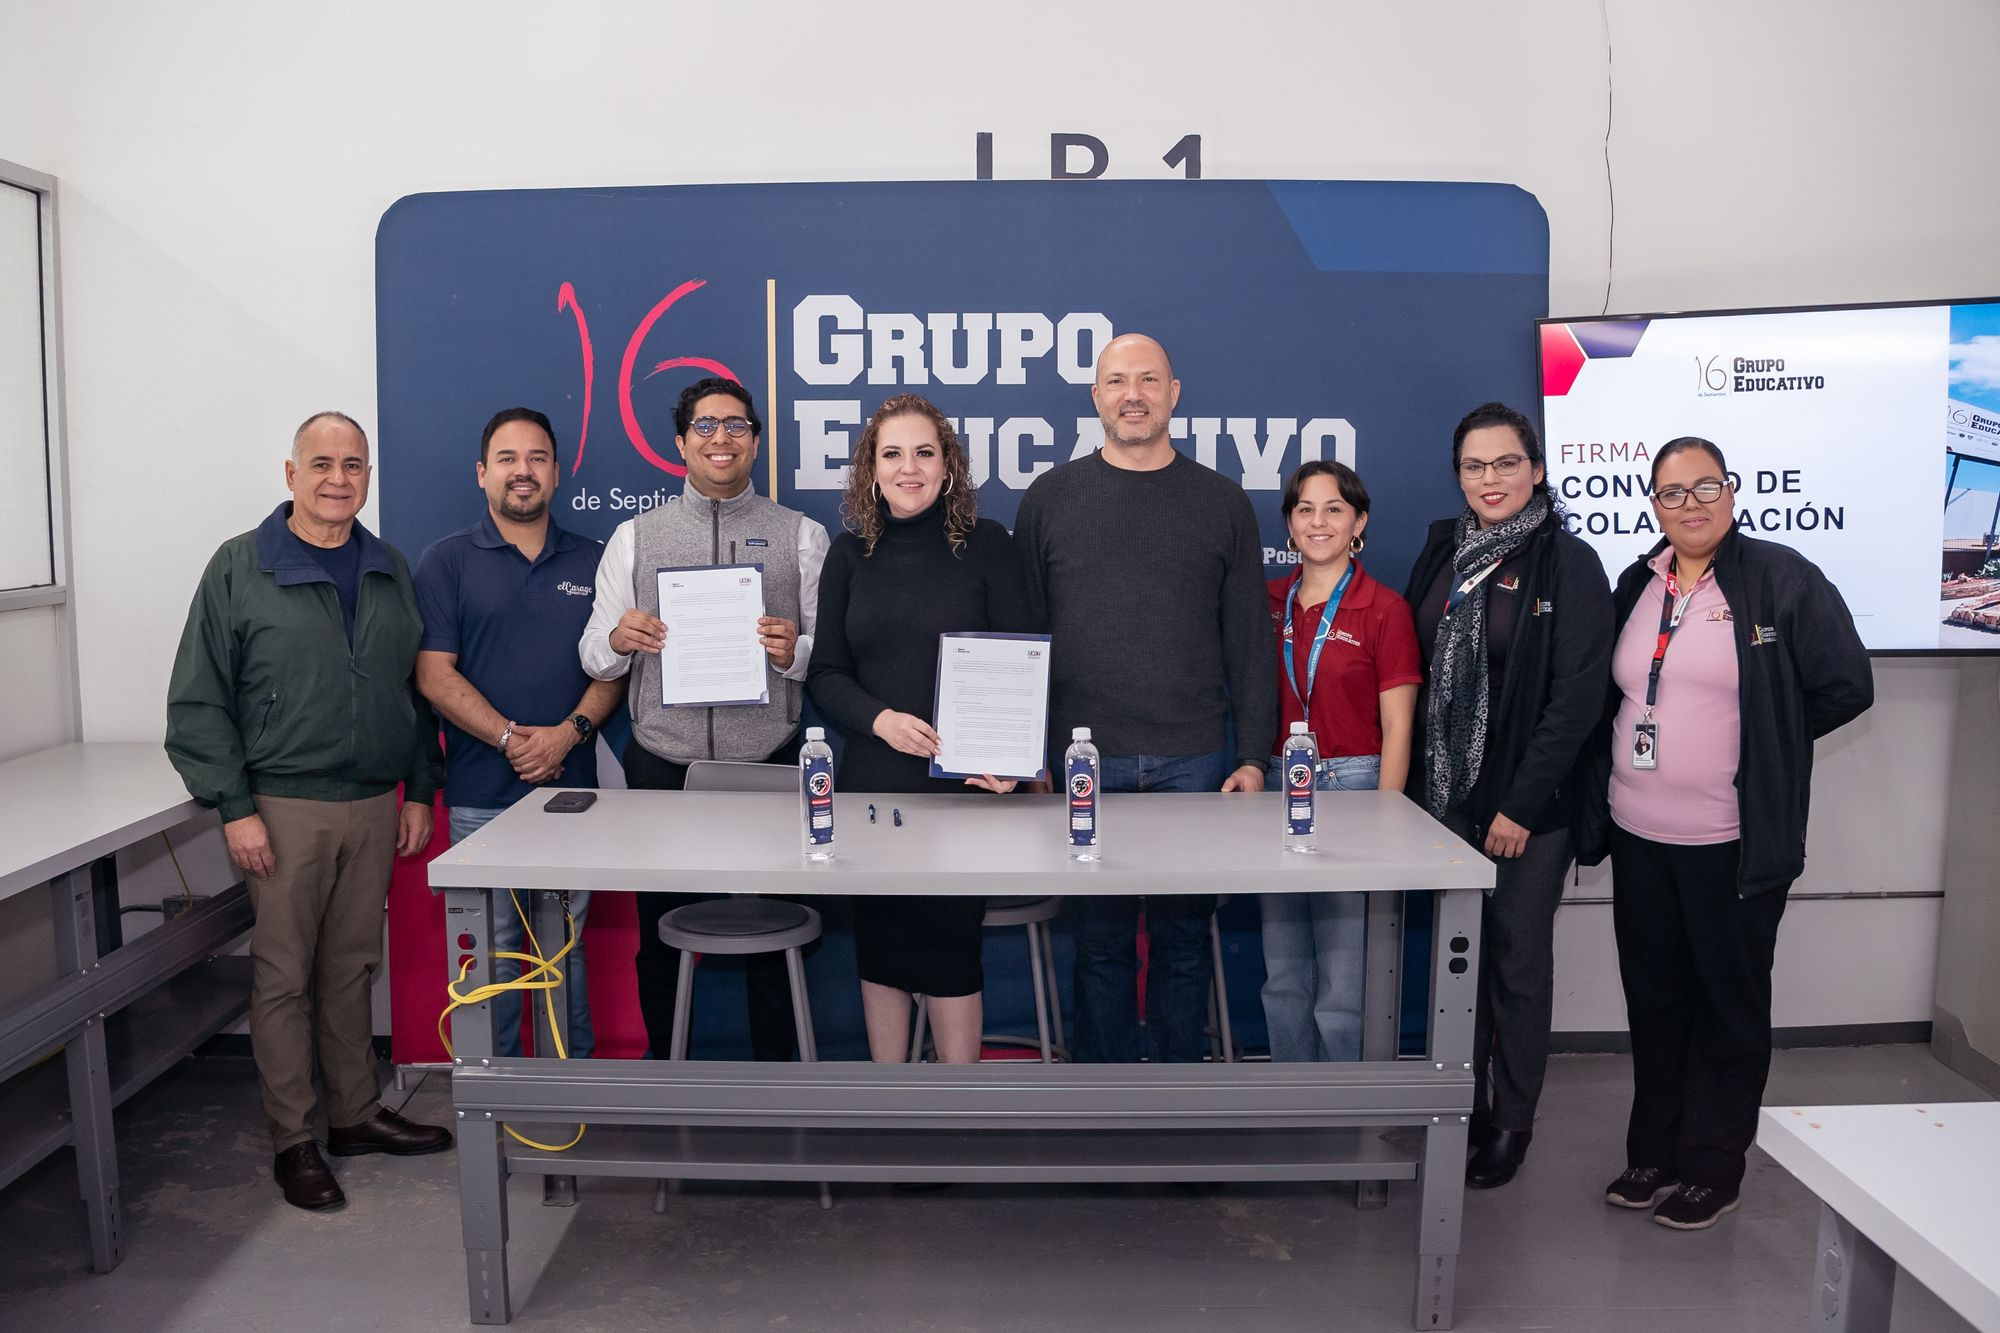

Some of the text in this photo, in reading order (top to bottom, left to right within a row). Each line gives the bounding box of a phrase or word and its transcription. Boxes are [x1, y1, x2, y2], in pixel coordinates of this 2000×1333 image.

[793, 294, 1113, 385] GRUPO
[558, 277, 743, 478] 16
[1695, 354, 1727, 391] 16
[1733, 356, 1785, 374] GRUPO
[1733, 375, 1825, 392] EDUCATIVO
[794, 400, 1356, 490] EUCIVO
[1560, 441, 1650, 464] FIRMA
[1756, 469, 1801, 494] DE
[572, 487, 600, 510] de
